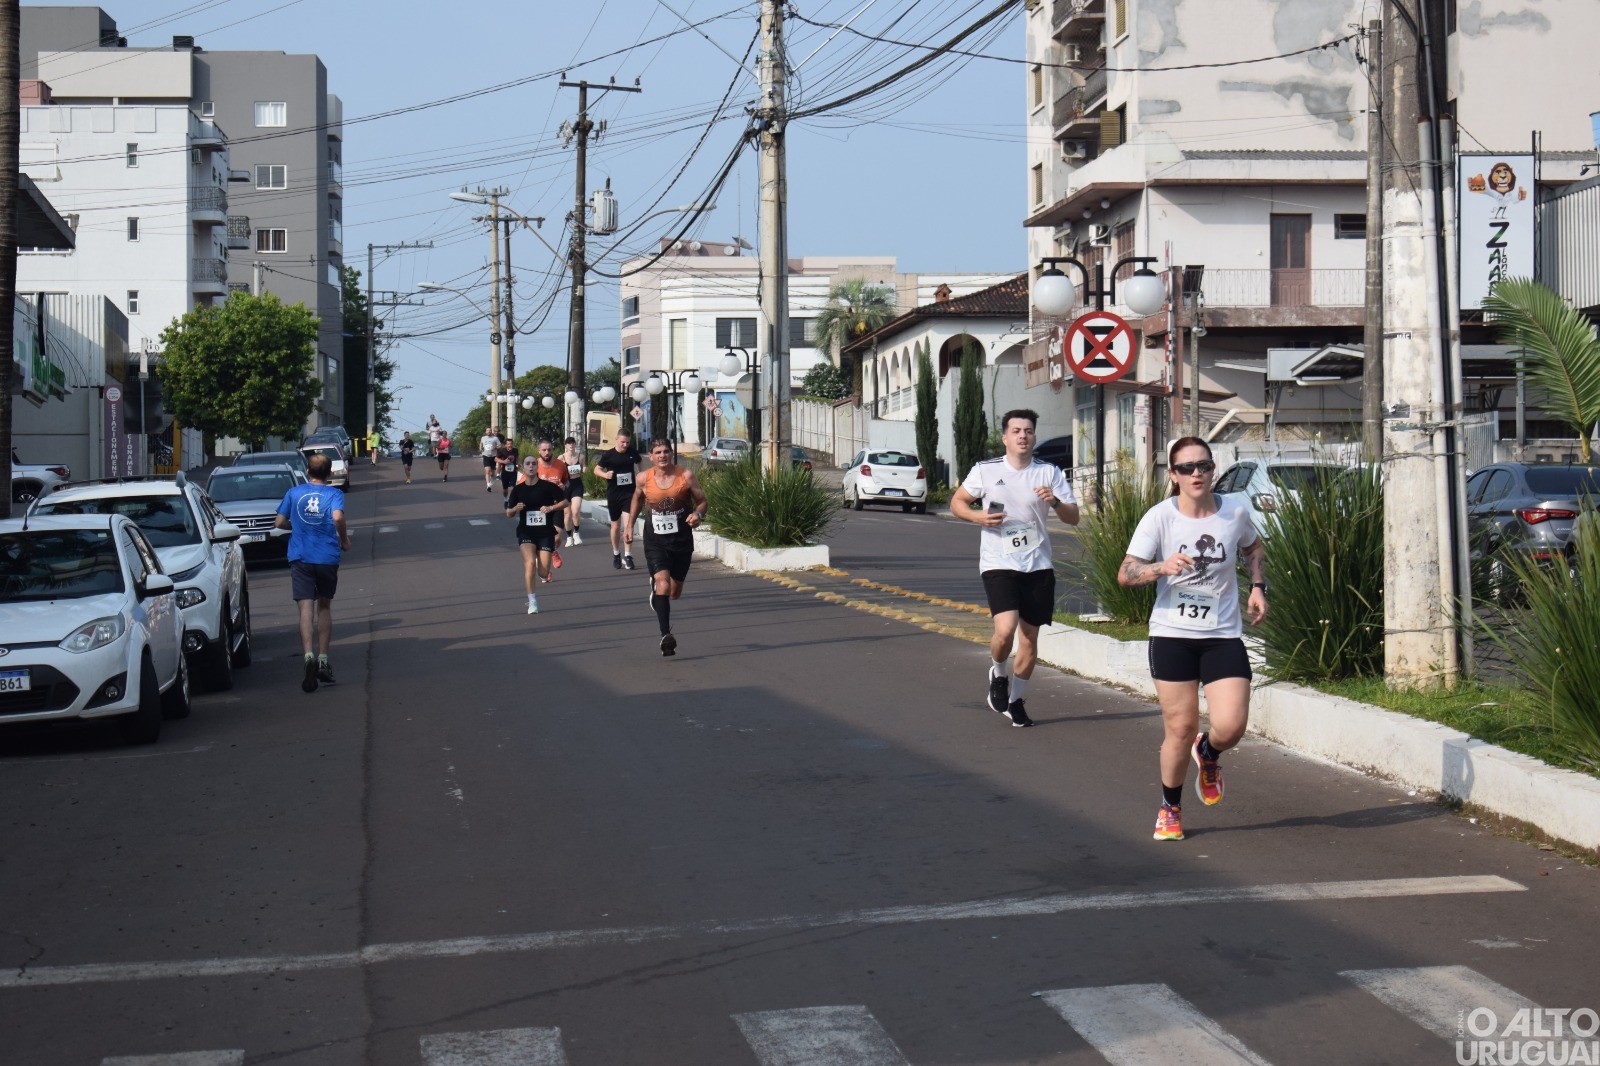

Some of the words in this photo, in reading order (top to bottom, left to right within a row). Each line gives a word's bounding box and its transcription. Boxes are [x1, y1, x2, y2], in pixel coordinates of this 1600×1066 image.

[1084, 326, 1114, 368] E
[656, 522, 674, 531] 113
[1012, 535, 1028, 548] 61
[1177, 602, 1211, 620] 137
